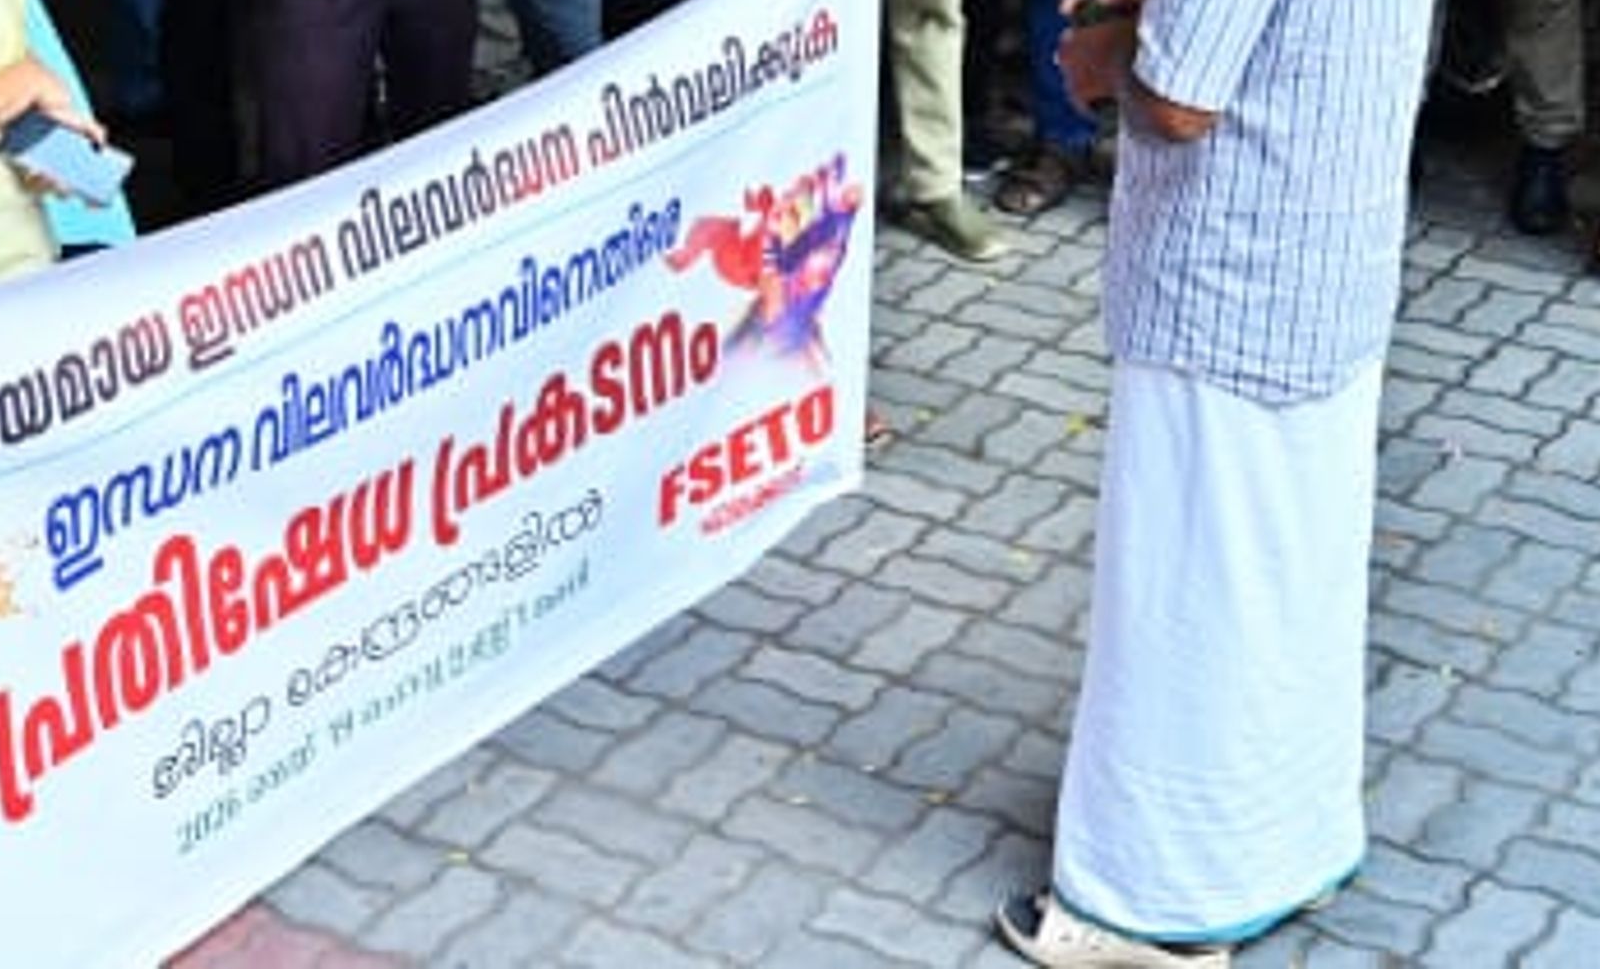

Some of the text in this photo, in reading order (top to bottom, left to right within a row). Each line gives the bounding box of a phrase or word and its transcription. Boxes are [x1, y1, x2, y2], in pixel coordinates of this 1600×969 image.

[180, 234, 332, 372] ഇന്ധന
[338, 123, 581, 278] വിലവർദ്ധന
[588, 9, 839, 169] പിൻവലിക്കുക
[46, 198, 683, 591] ഇന്ധന വിലവർദ്ധനവിനെതിരെ
[431, 311, 718, 548] പ്രകടനം
[658, 385, 834, 528] FSETO
